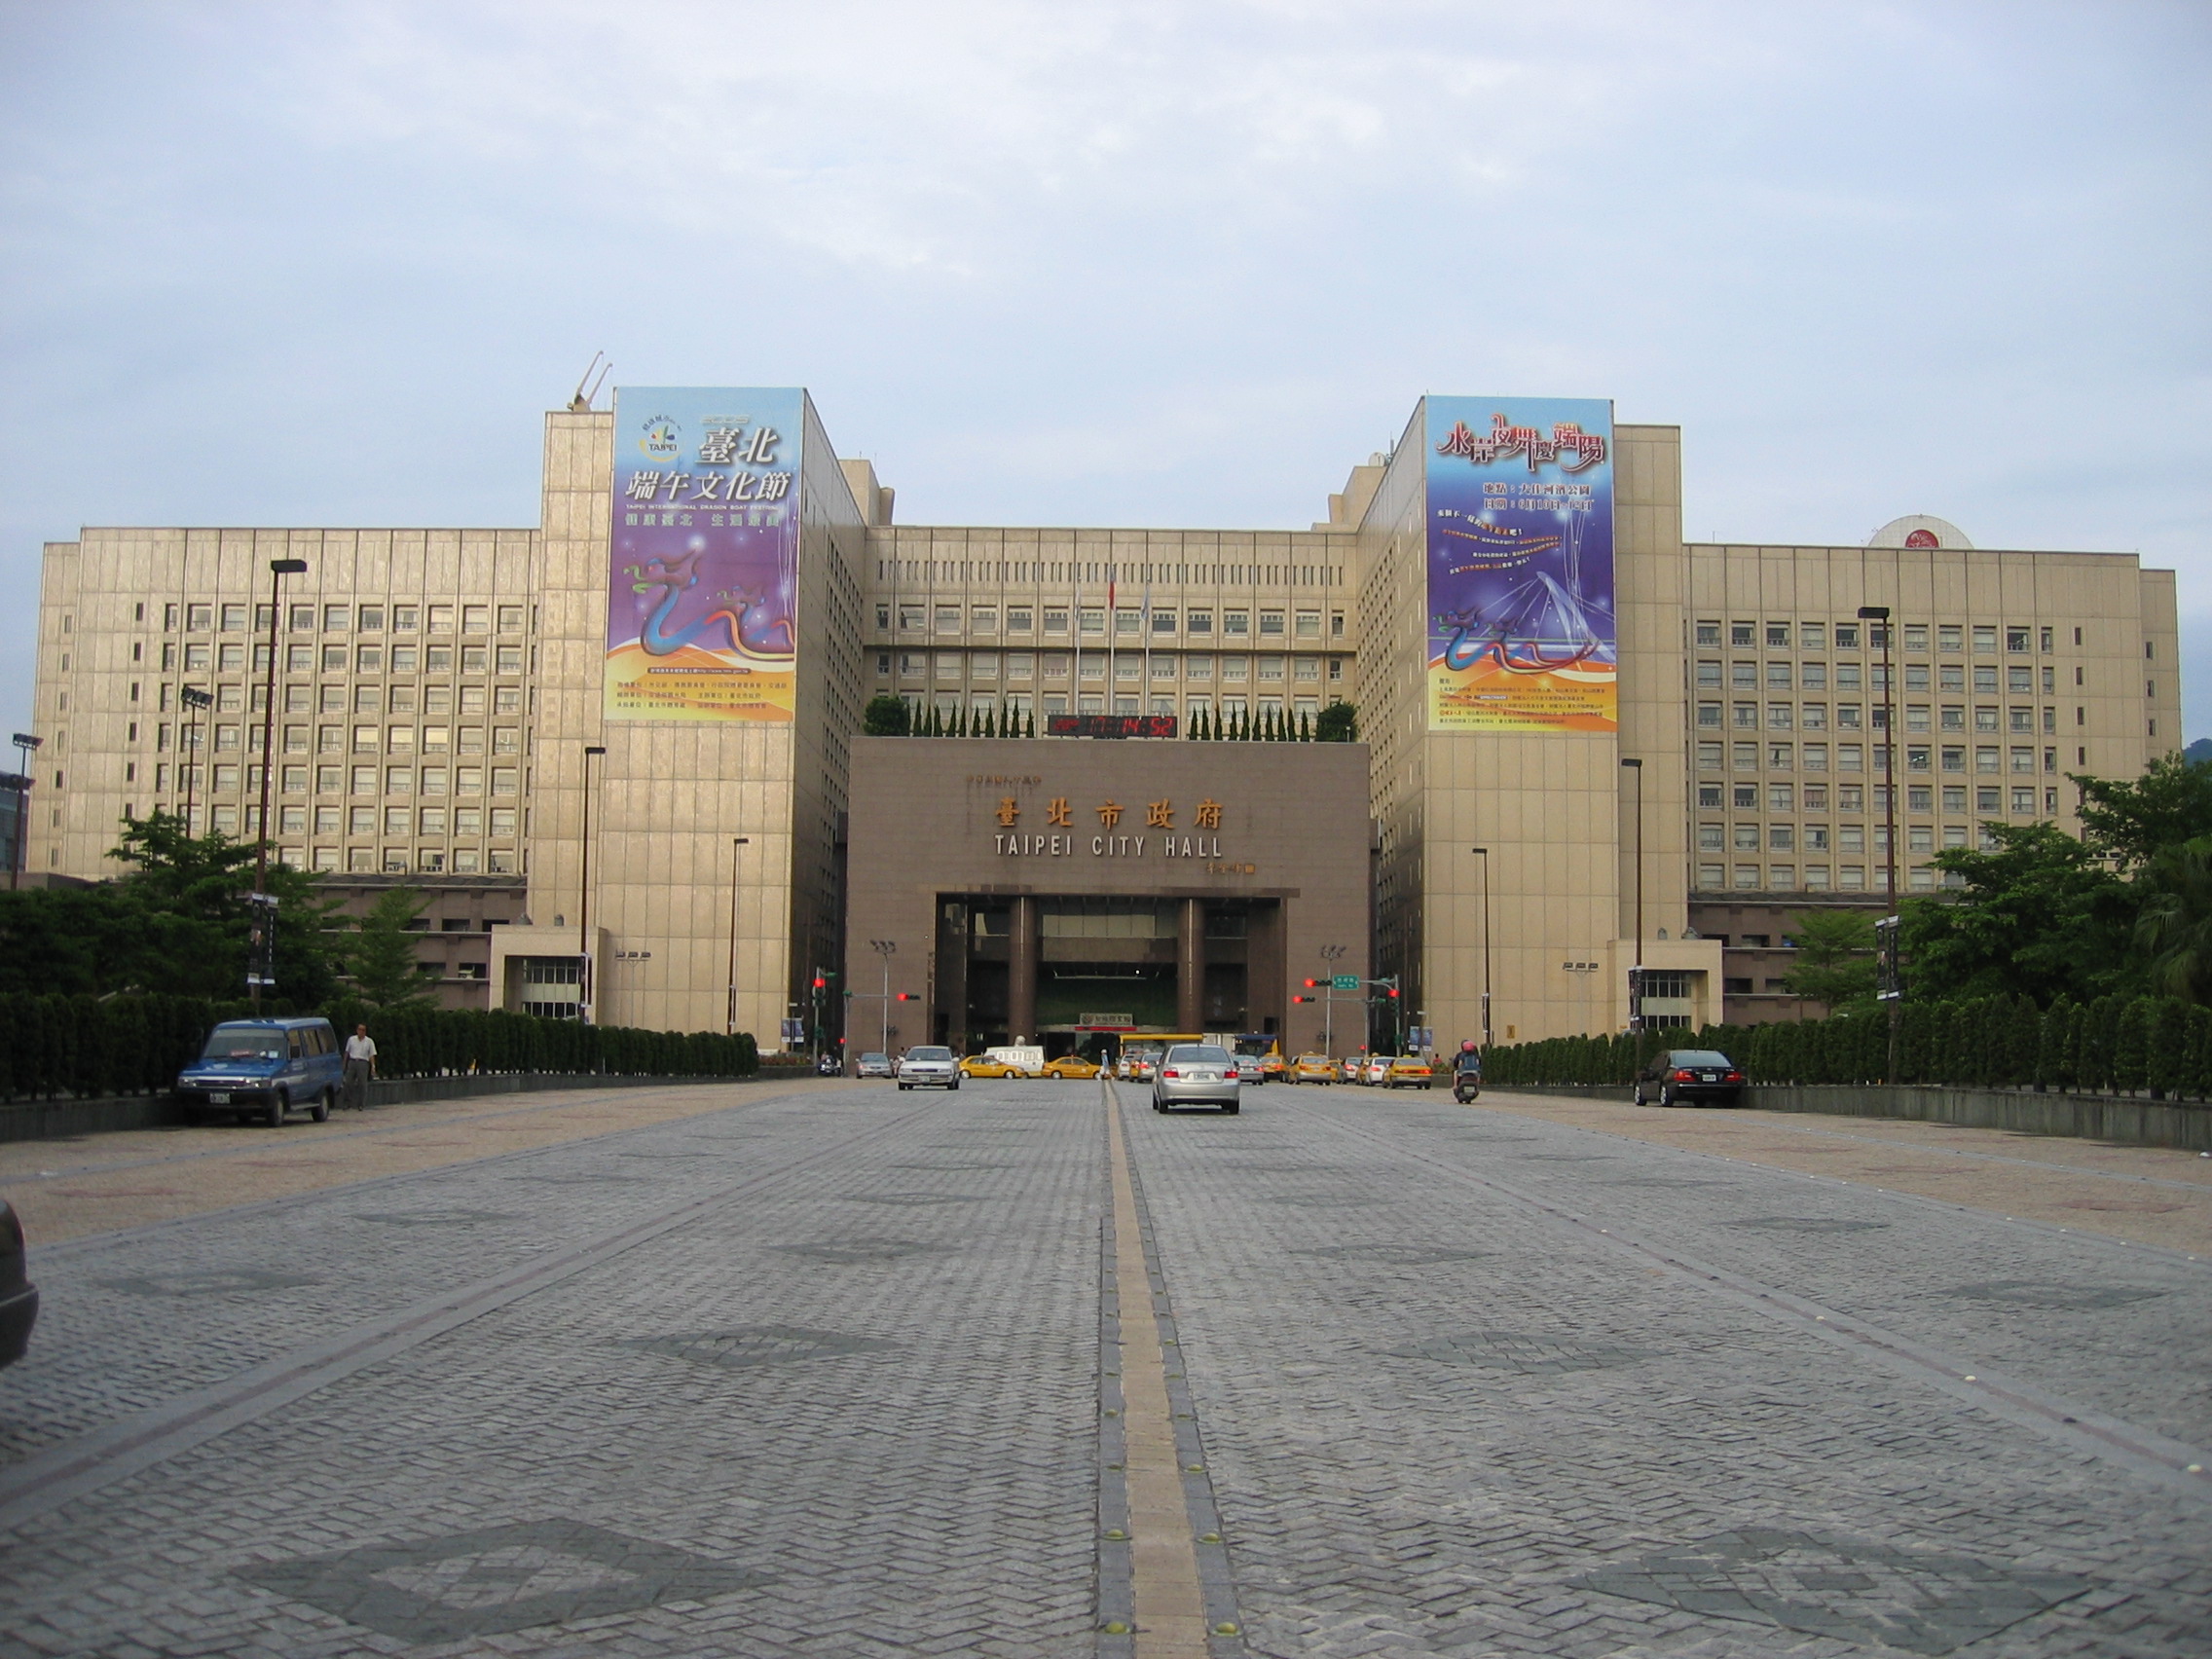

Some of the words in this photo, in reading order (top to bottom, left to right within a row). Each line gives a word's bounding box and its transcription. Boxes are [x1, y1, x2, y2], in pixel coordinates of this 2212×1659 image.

[648, 443, 677, 452] TAIPEI
[695, 426, 778, 463] 臺北
[625, 470, 792, 501] 端午文化節
[995, 796, 1224, 830] 臺北市政府
[995, 834, 1071, 855] TAIPEI
[1091, 835, 1145, 856] CITY
[1165, 836, 1222, 857] HALL
